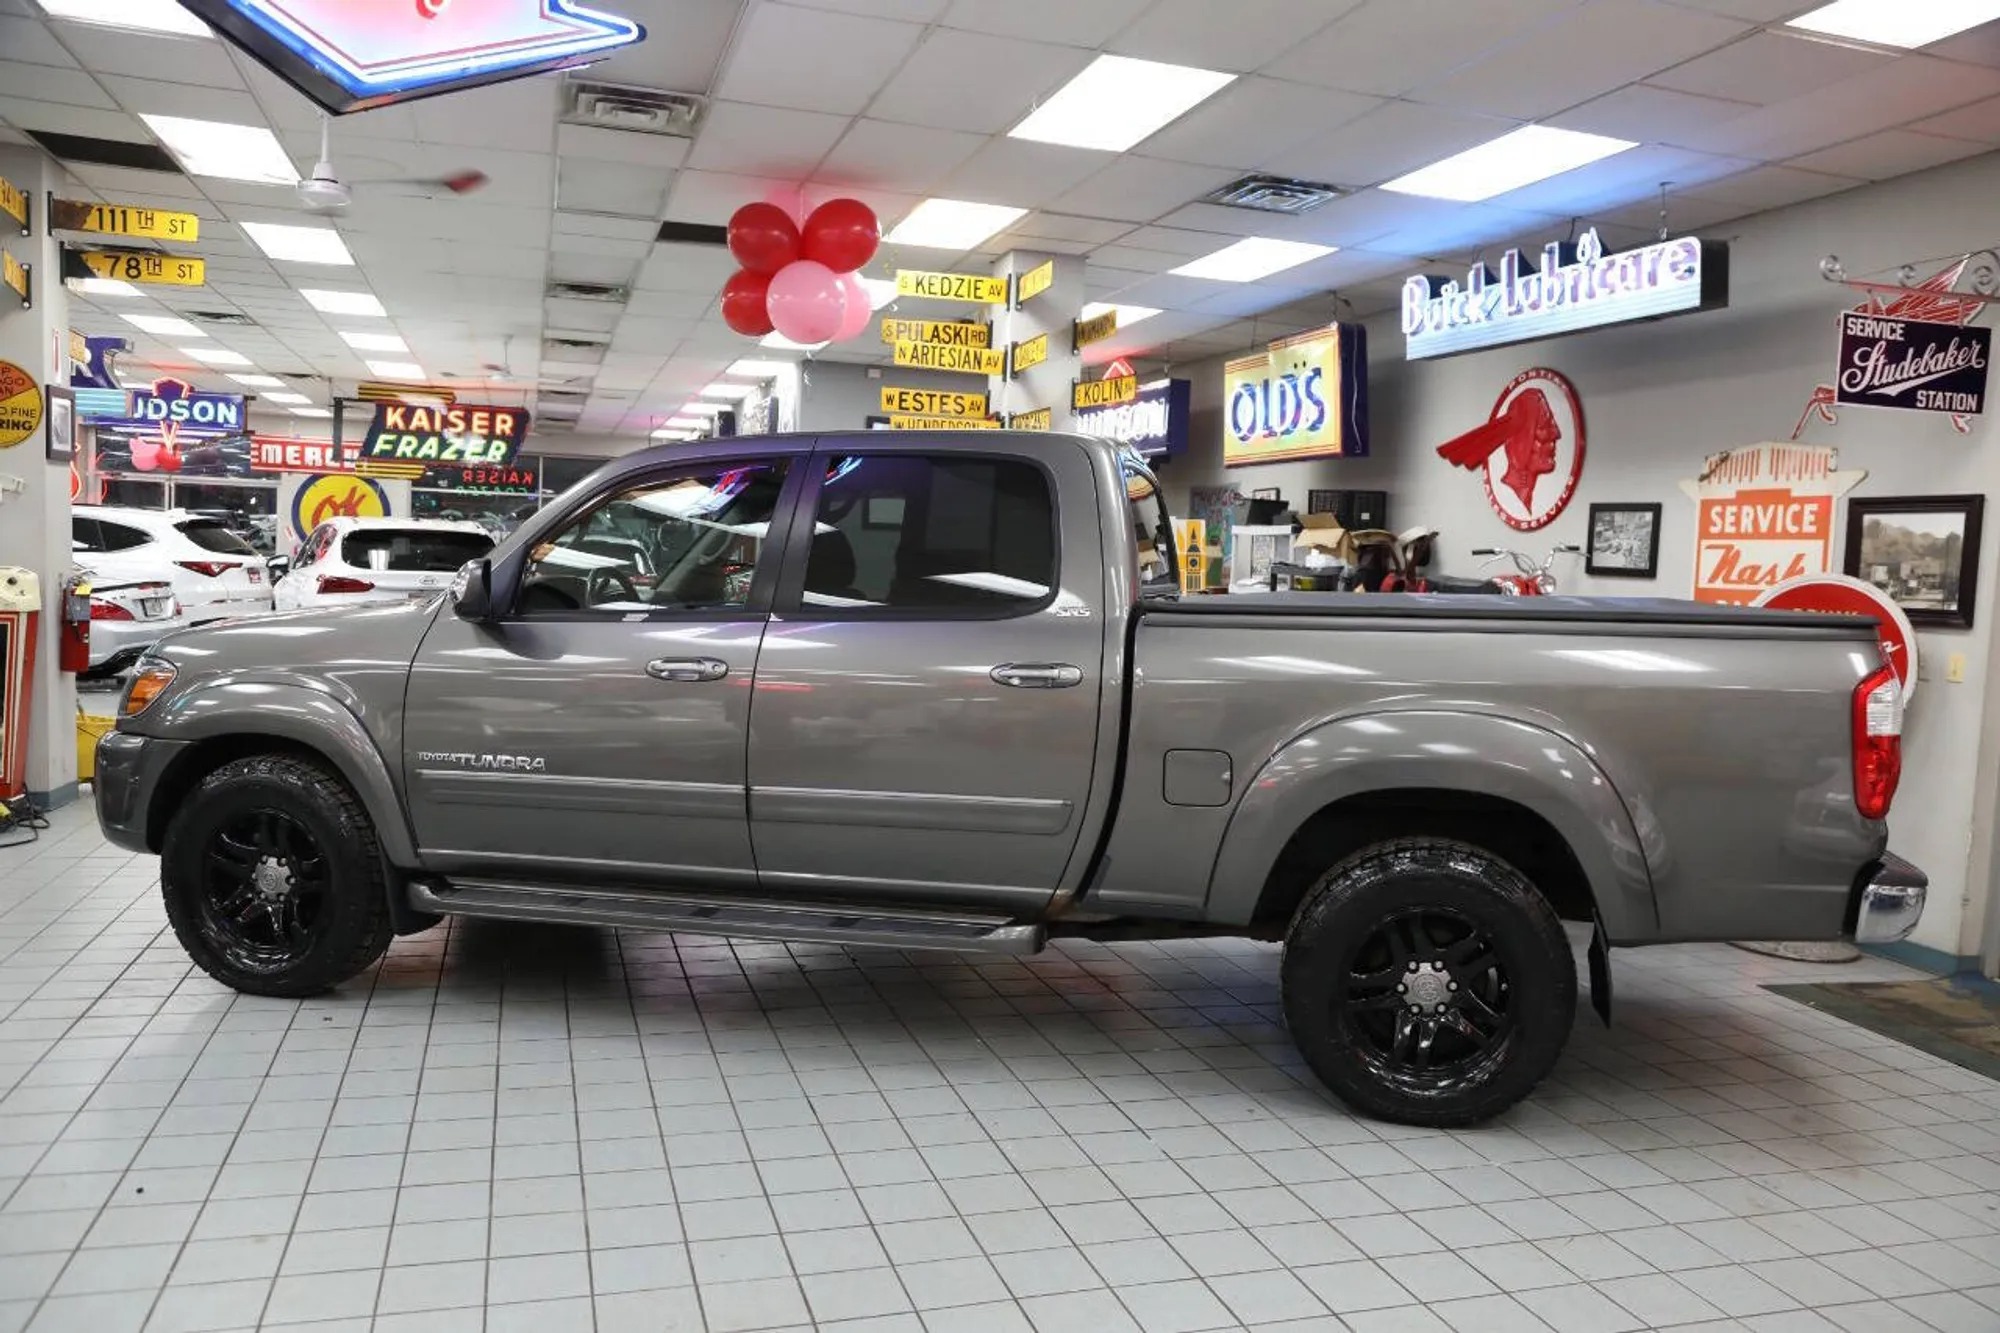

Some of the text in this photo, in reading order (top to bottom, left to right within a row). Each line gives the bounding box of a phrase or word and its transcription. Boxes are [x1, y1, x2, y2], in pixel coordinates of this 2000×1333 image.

[169, 219, 187, 234] ST
[177, 264, 194, 279] ST
[914, 274, 984, 300] KEDZIE
[987, 284, 1003, 298] AV
[1402, 262, 1494, 336] Buick
[885, 322, 986, 346] S PULASKI RD
[1846, 317, 1906, 341] SERVICE
[899, 344, 1000, 370] N ARTESIAN AV
[1840, 336, 1986, 393] Studebaker
[885, 391, 984, 415] W ESTES AV
[1084, 377, 1122, 403] KOLIN
[1916, 389, 1978, 412] STATION
[11, 408, 36, 418] FINE
[386, 406, 514, 436] KAISER
[372, 433, 508, 462] FRAZER
[1708, 503, 1819, 534] SERVICE
[1705, 544, 1806, 586] Nash
[416, 752, 547, 771] TOYOTA TUNDRA
